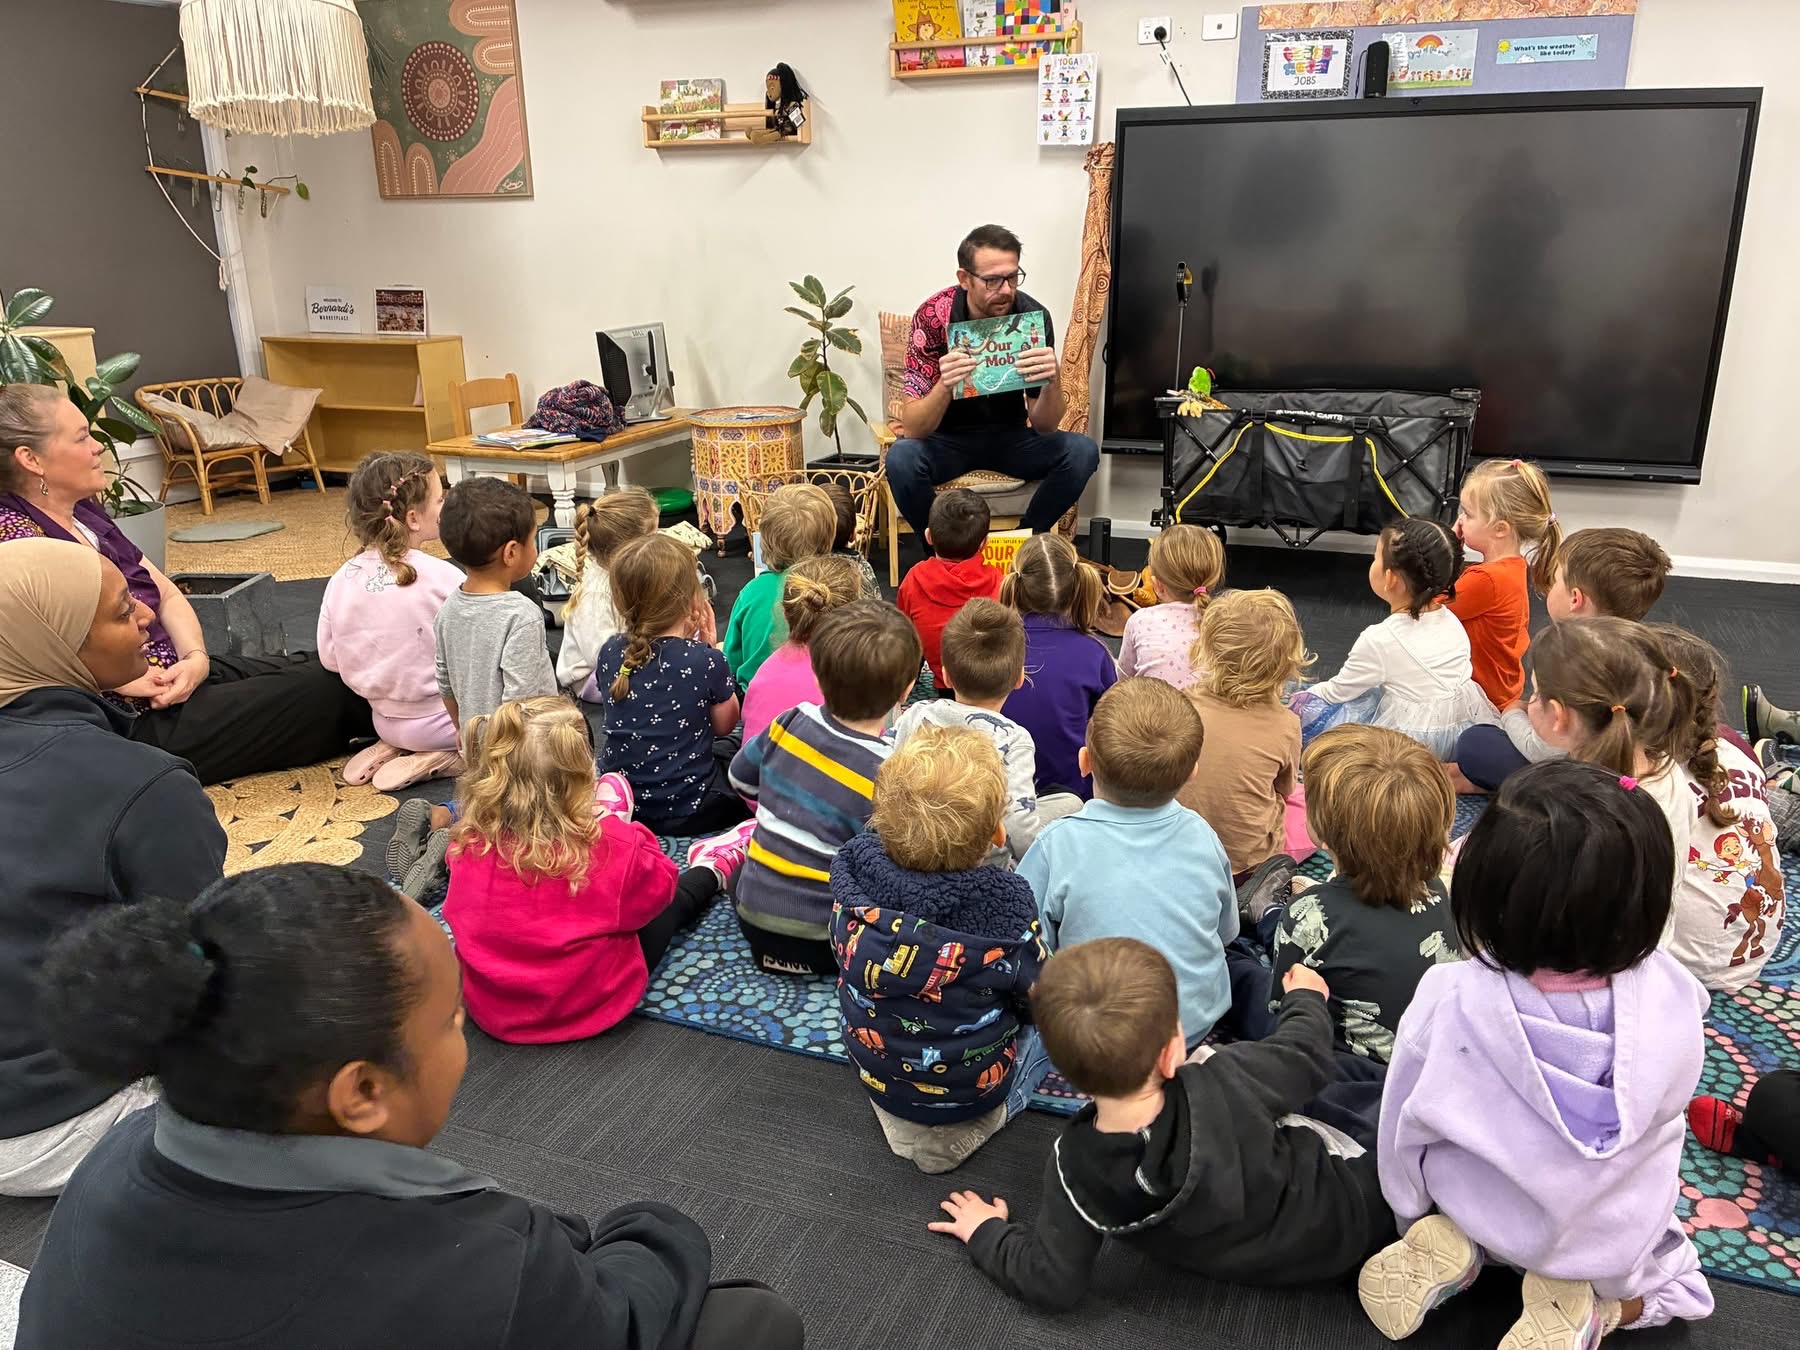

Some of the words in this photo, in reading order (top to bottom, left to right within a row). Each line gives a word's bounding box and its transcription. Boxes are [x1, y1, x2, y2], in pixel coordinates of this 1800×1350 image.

[1058, 58, 1079, 66] YOGA
[1294, 76, 1317, 86] JOBS
[985, 340, 1012, 353] Our
[984, 353, 1015, 368] Mob
